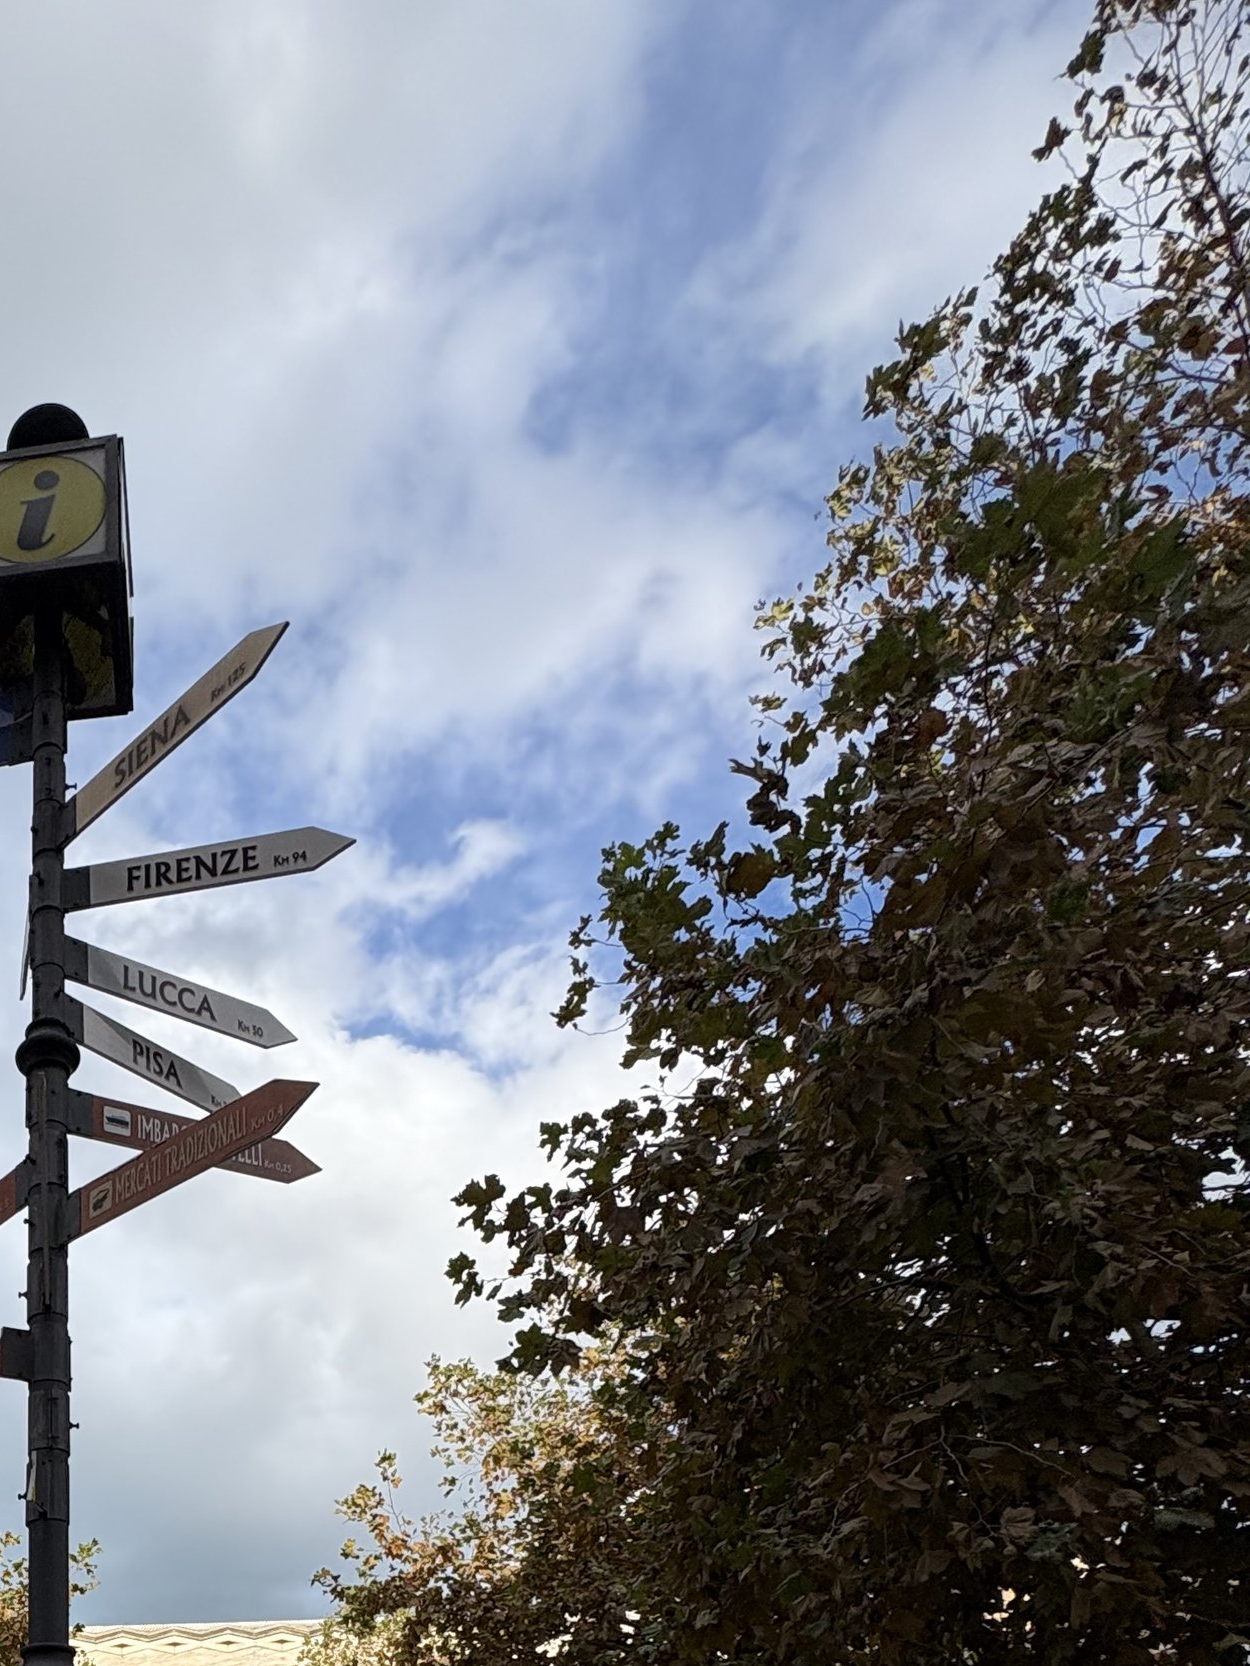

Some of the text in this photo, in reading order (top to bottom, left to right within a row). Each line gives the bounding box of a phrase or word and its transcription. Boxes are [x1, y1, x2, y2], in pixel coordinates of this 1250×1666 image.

[114, 705, 191, 789] SIENA
[227, 661, 246, 687] 125
[126, 845, 260, 892] FIRENZE
[292, 851, 307, 864] 94
[123, 964, 217, 1023] LUCCA
[252, 1026, 264, 1038] 50
[132, 1038, 183, 1090] PISA
[115, 1156, 162, 1203] MERCATI
[165, 1106, 247, 1177] TRADIZIONALI
